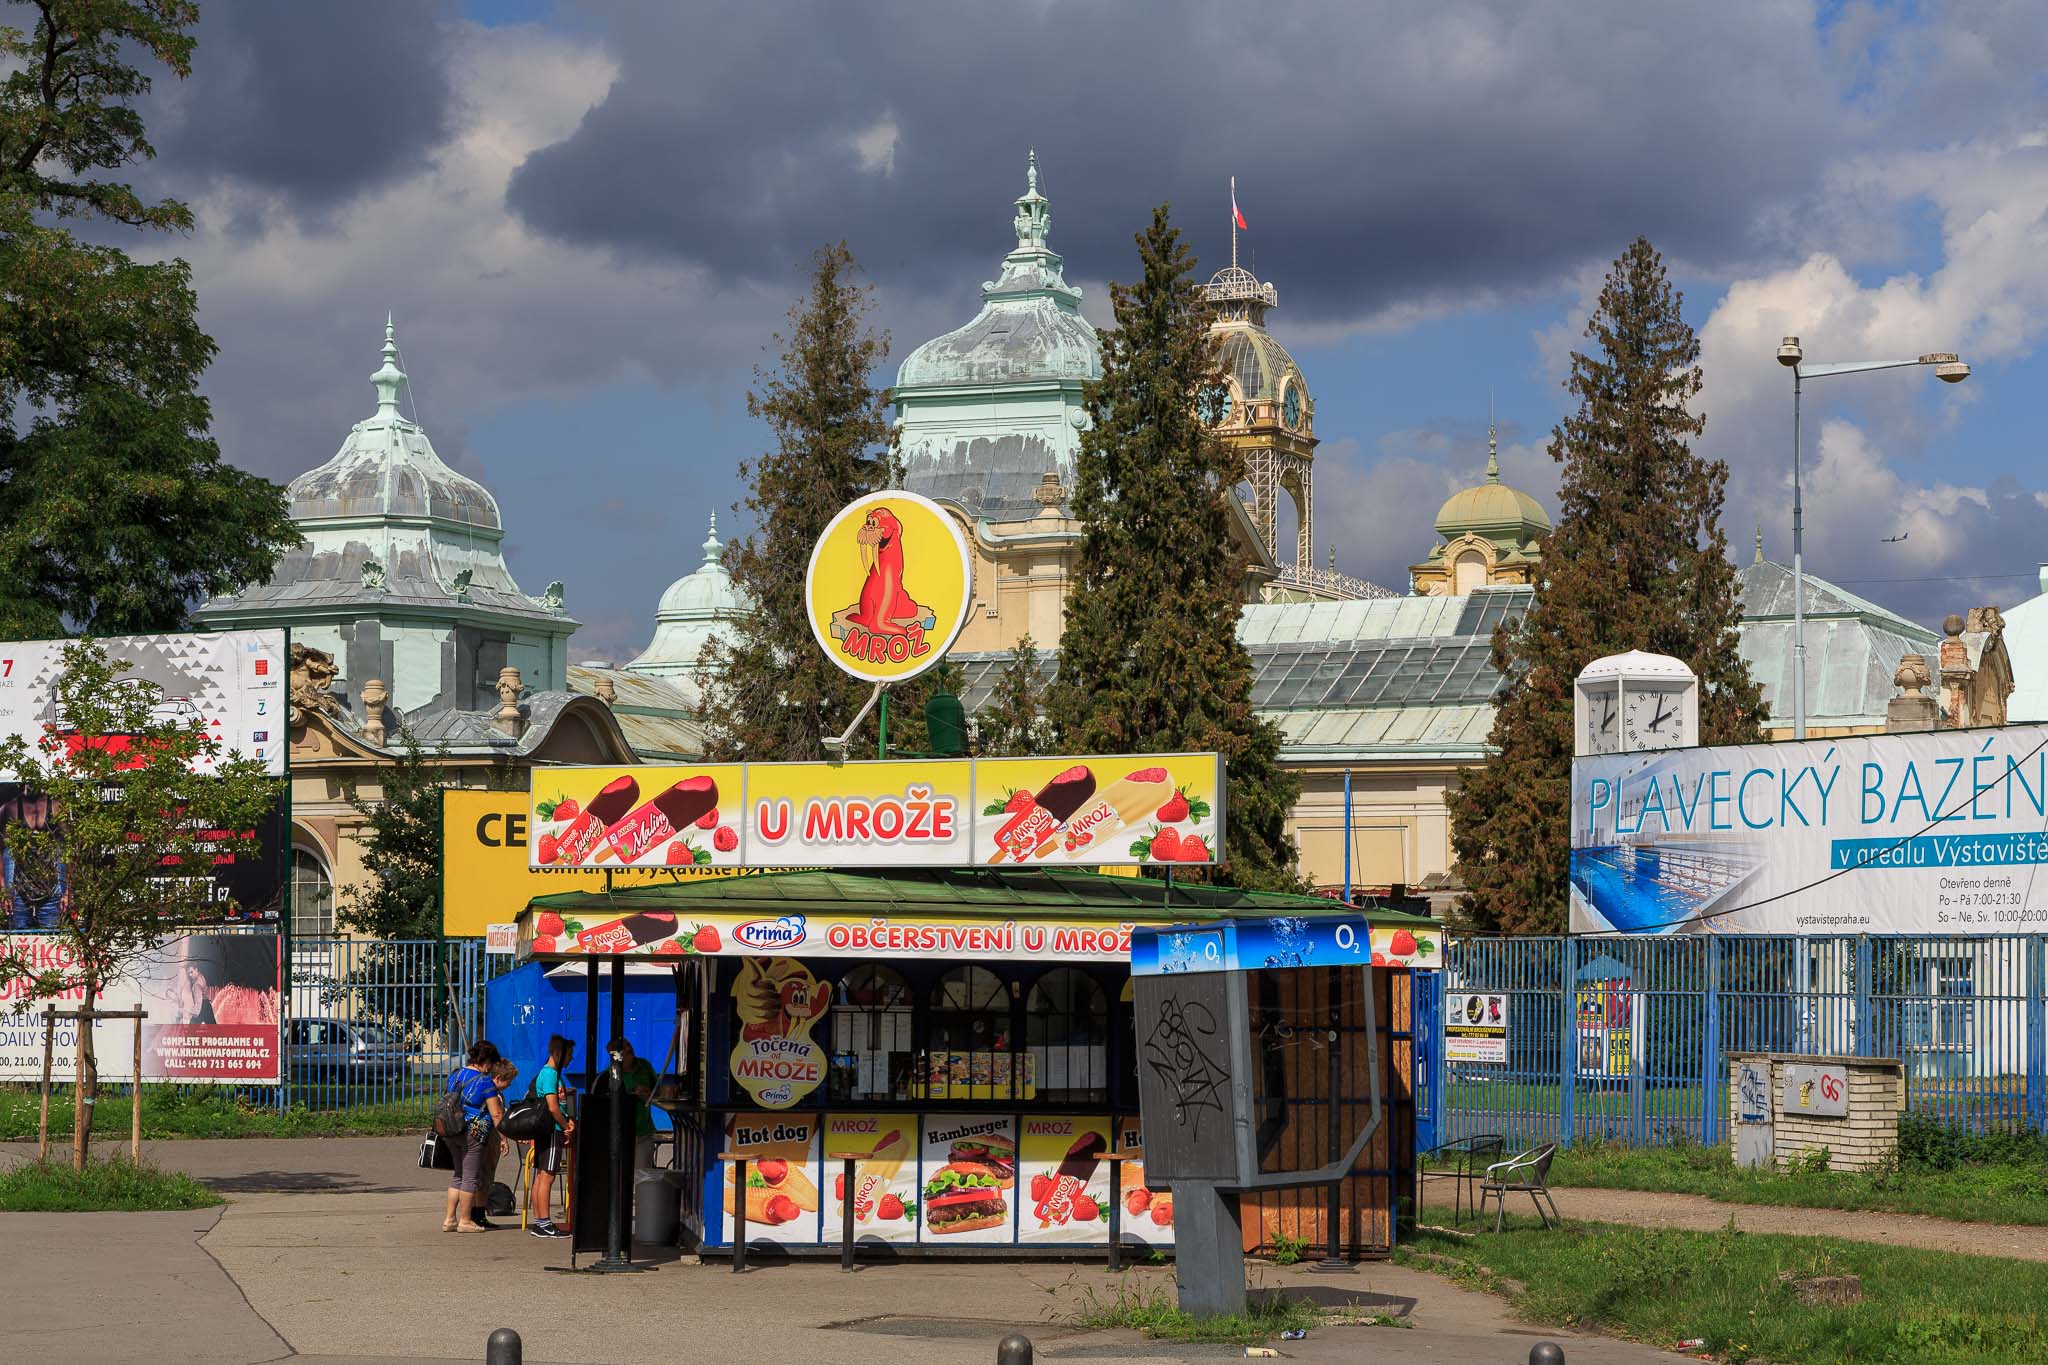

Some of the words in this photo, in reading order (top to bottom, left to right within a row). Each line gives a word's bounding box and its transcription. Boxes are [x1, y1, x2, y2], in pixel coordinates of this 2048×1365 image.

[842, 623, 930, 663] MROŽ
[2, 659, 13, 677] 7
[1590, 747, 1841, 835] PLAVECKÝ
[1861, 736, 2046, 825] BAZÉN
[760, 802, 788, 841] U
[804, 788, 954, 841] MROŽE
[1014, 806, 1049, 840] MROŽ
[1071, 802, 1113, 835] MROŽ
[476, 812, 527, 848] CE
[574, 815, 602, 861] Jahody
[1839, 849, 1850, 865] v
[1857, 839, 1926, 866] areálu
[1934, 833, 2048, 868] Výstaviště
[1940, 877, 1981, 889] Otevřeno
[1983, 875, 2012, 888] denně
[1939, 894, 1950, 905] Po
[1960, 894, 1971, 905] Pá
[1974, 892, 2021, 905] 7:00-21:30
[1796, 912, 1870, 927] vystavistepraha.eu
[1938, 911, 1949, 922] So
[1958, 911, 1975, 924] Ne,
[1977, 910, 1990, 922] Sv.
[1994, 909, 2048, 922] 10:00-20:00
[595, 927, 628, 946] MROŽ
[745, 925, 793, 941] Prima
[828, 920, 1014, 950] OBČERSTVENÍ
[1024, 929, 1044, 951] U
[161, 1036, 200, 1046] COMPLETE
[202, 1037, 251, 1047] PROGRAMME
[253, 1037, 264, 1047] ON
[751, 1036, 811, 1057] Točená
[15, 1056, 41, 1067] 21.00,
[165, 1059, 186, 1068] CALL:
[188, 1059, 207, 1069] +420
[210, 1060, 225, 1069] 723
[227, 1060, 243, 1069] 665
[246, 1060, 262, 1069] 694
[737, 1058, 819, 1081] MROŽE
[765, 1091, 788, 1100] Prima
[737, 1127, 770, 1144] Hot
[773, 1124, 808, 1142] dog
[831, 1119, 878, 1133] MROŽ
[928, 1119, 1009, 1145] Hamburger
[1026, 1119, 1073, 1134] MROŽ
[856, 1175, 878, 1207] MROŽ
[1050, 1176, 1074, 1208] MROŽ
